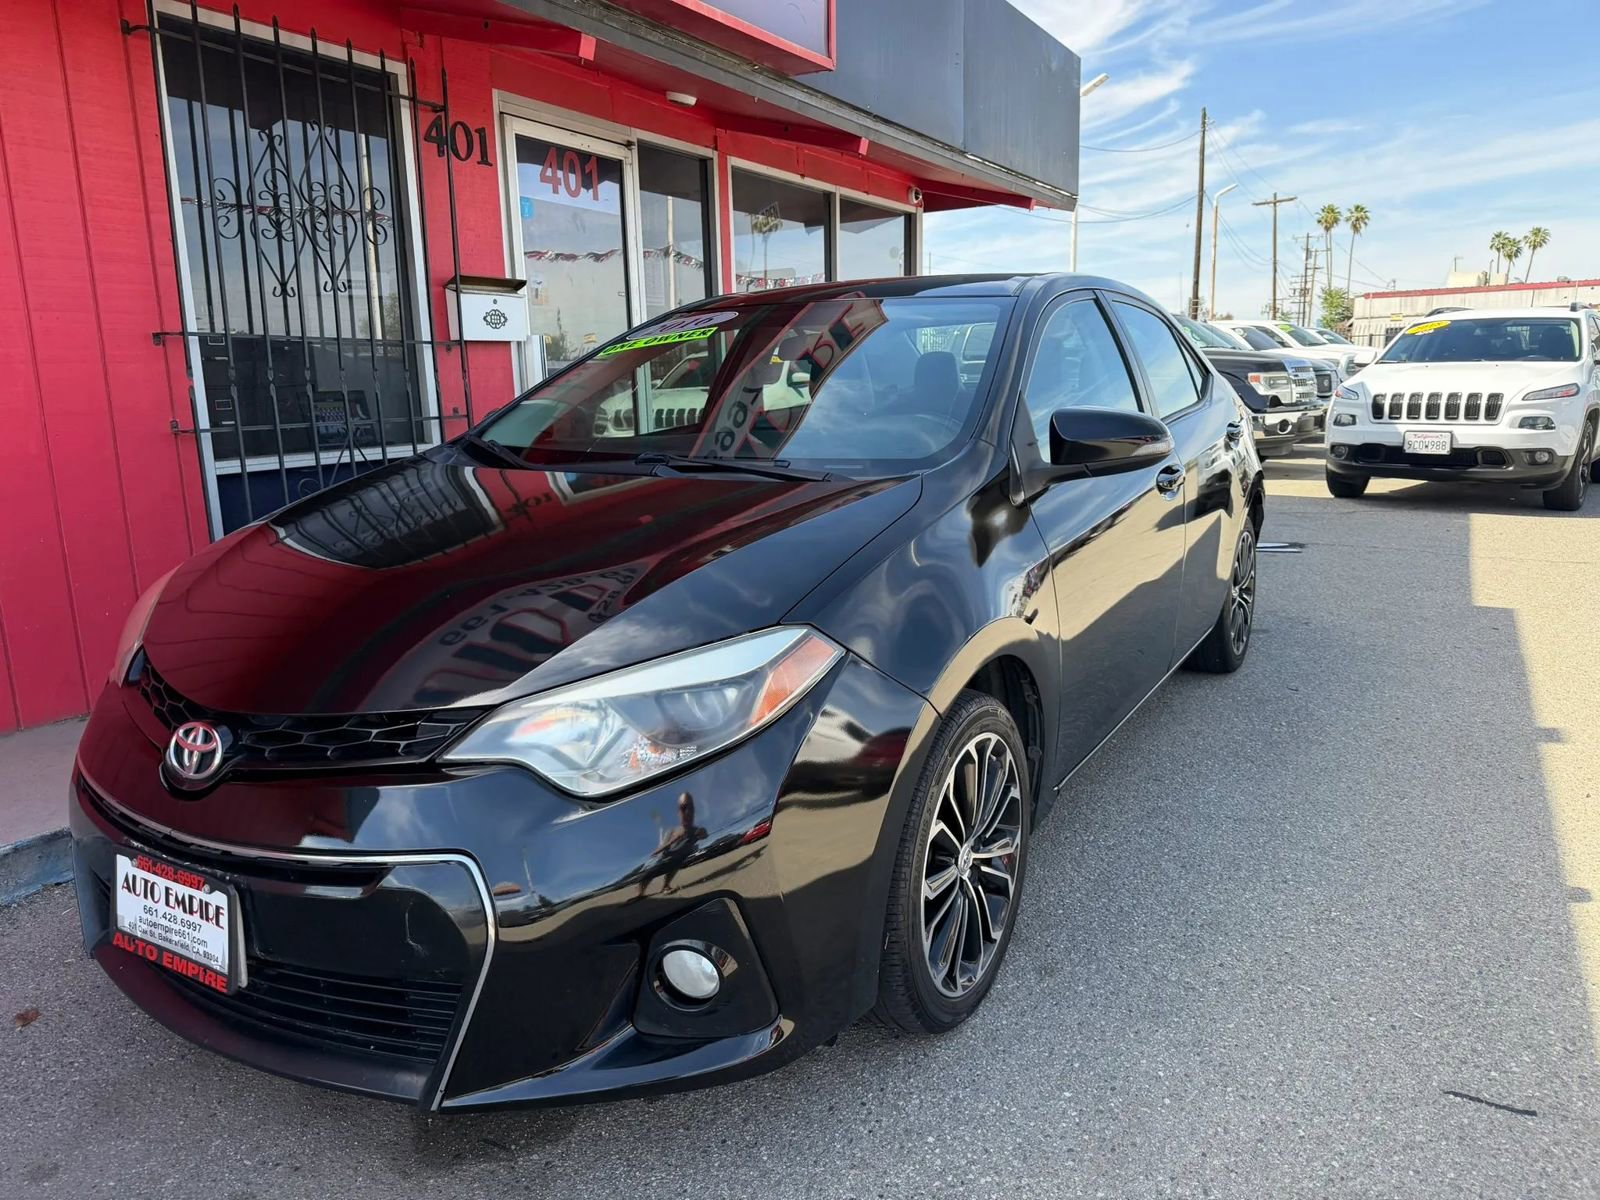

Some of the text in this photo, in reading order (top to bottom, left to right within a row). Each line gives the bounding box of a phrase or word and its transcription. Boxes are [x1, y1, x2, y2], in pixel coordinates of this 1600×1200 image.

[424, 115, 492, 167] 401
[540, 147, 599, 201] 401
[601, 328, 711, 354] ONE OWNER
[136, 855, 205, 891] 661-428-6997
[121, 871, 225, 930] AUTO EMPIRE
[143, 905, 202, 933] 661.428.6997
[138, 915, 208, 948] autoempire661.com
[113, 931, 229, 993] AUTO EMPIRE
